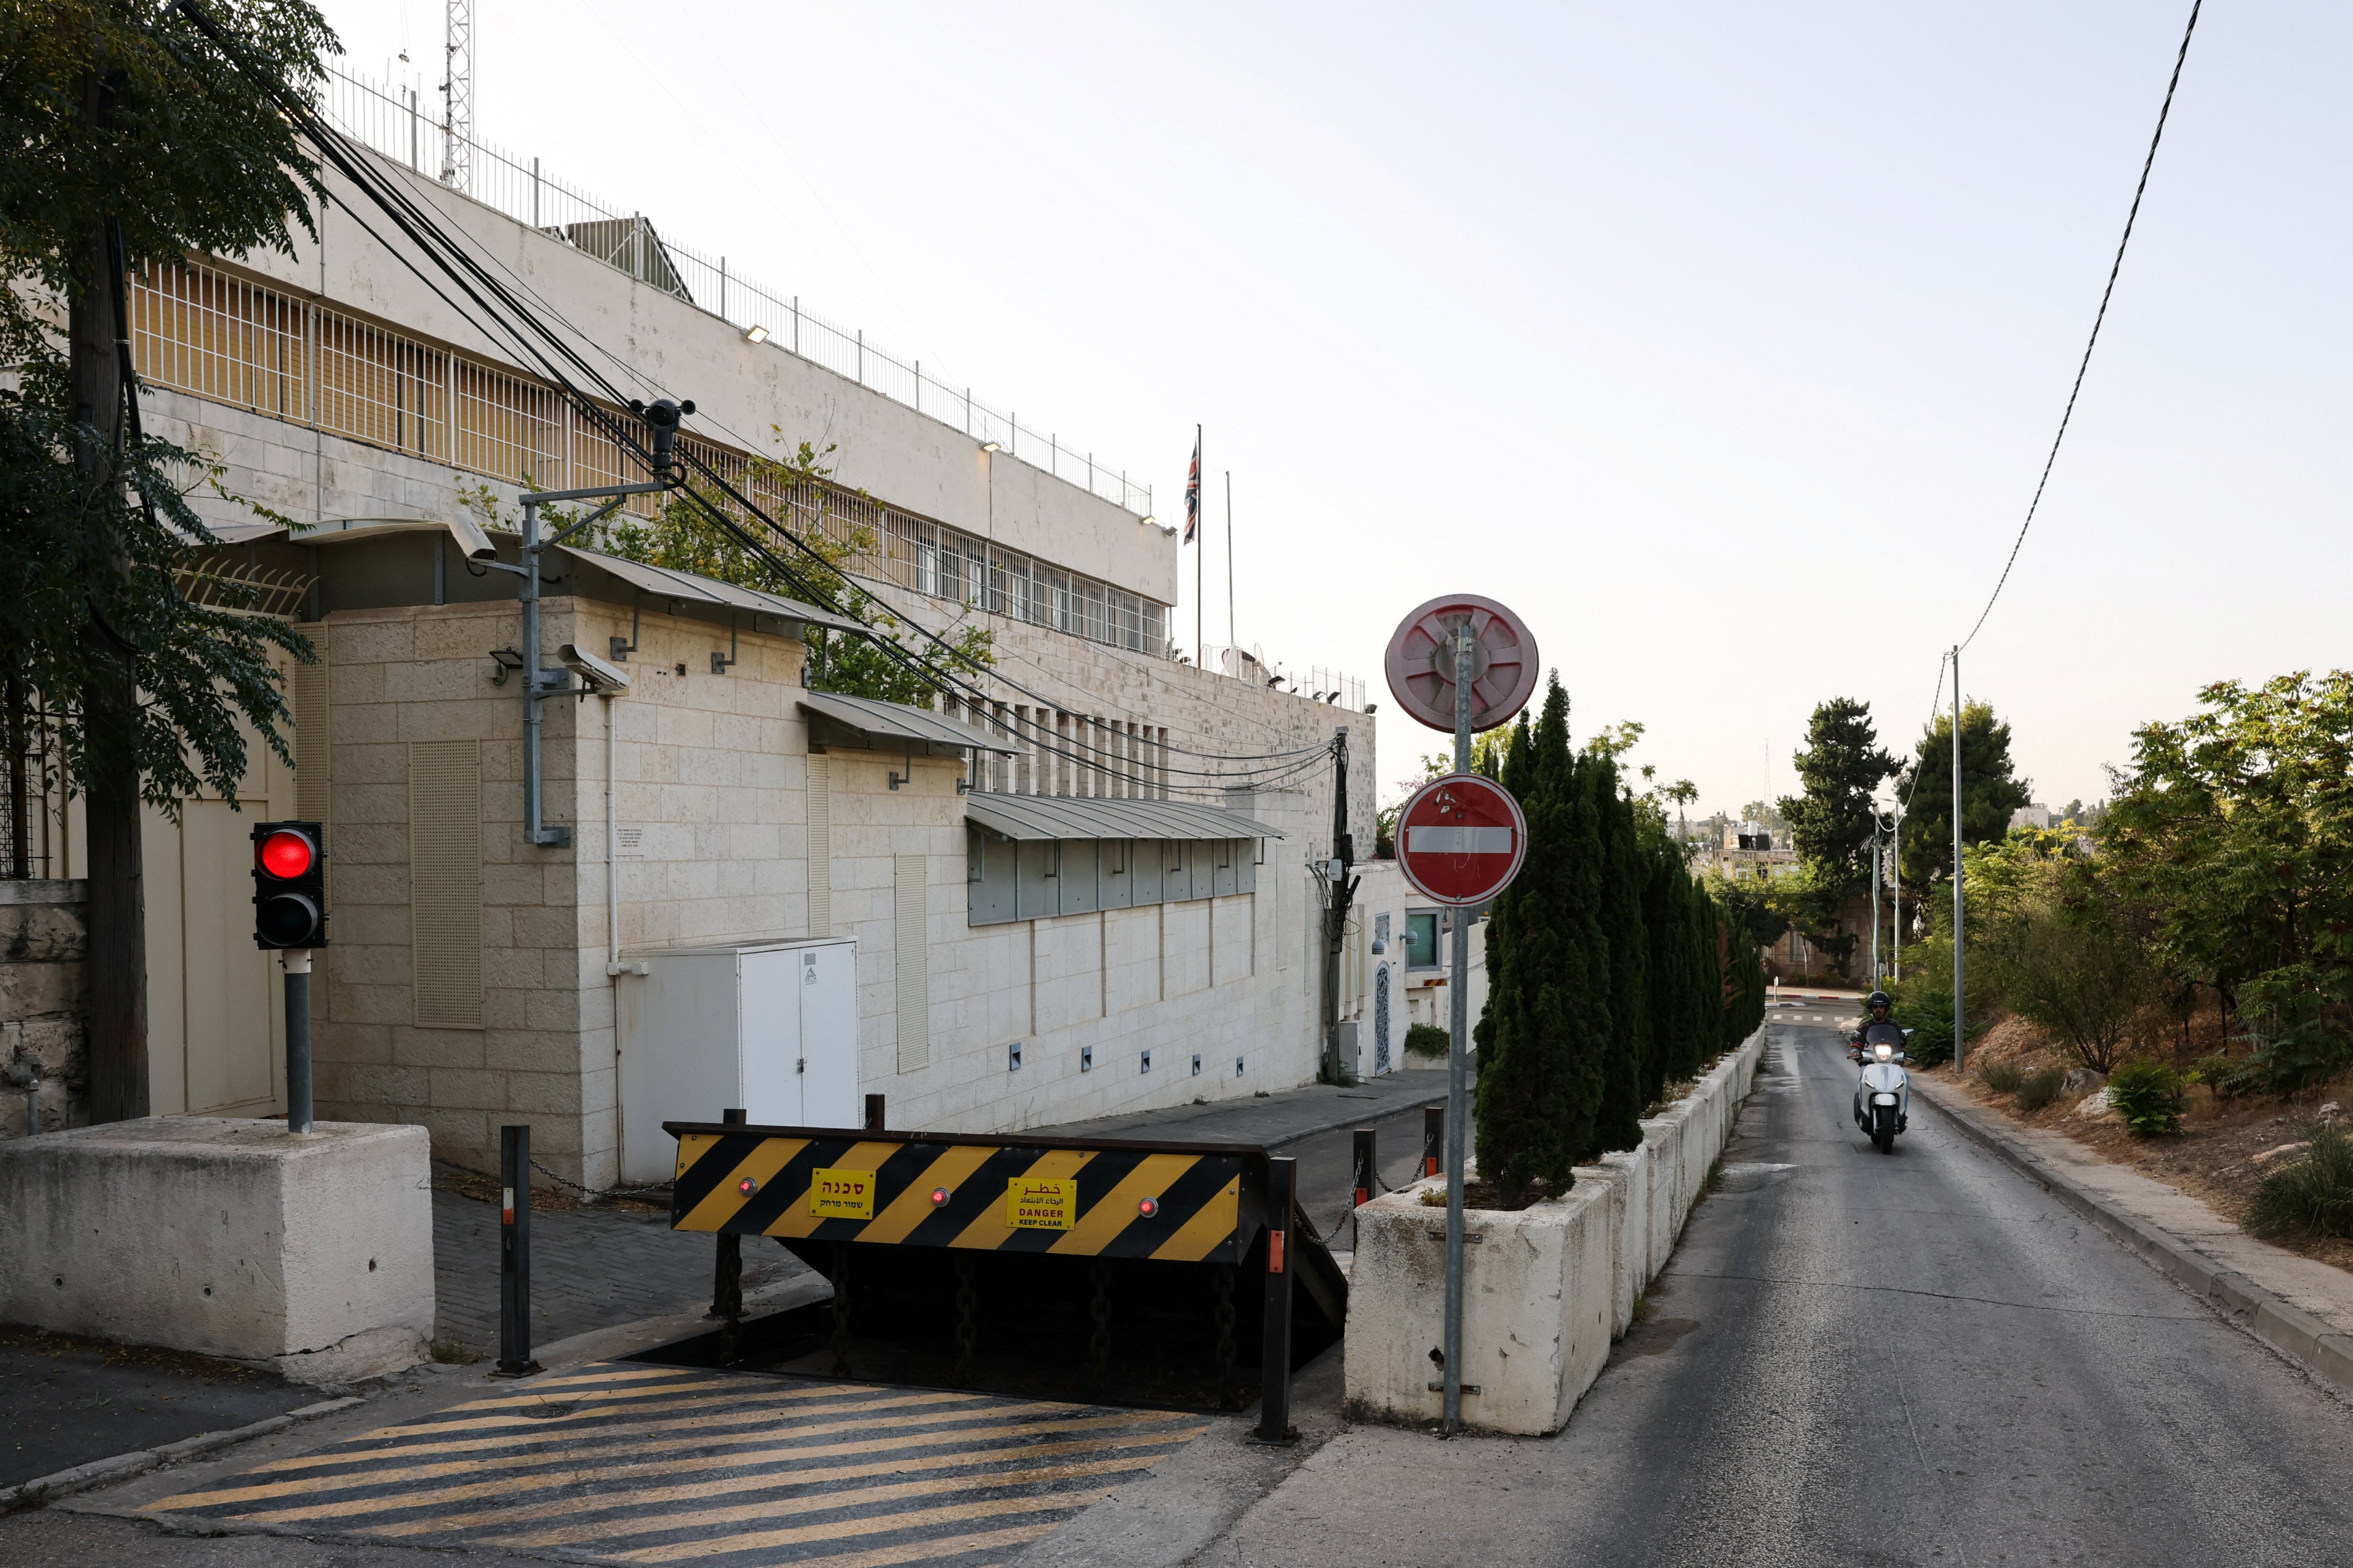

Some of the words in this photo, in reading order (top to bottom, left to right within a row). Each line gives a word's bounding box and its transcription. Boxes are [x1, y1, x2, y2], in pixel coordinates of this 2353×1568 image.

[822, 1181, 864, 1195] סכנה
[1024, 1183, 1060, 1195] خطر
[820, 1199, 841, 1208] מרחק
[844, 1200, 863, 1208] שמור
[1020, 1197, 1043, 1205] الابتعاد
[1019, 1208, 1063, 1218] DANGER
